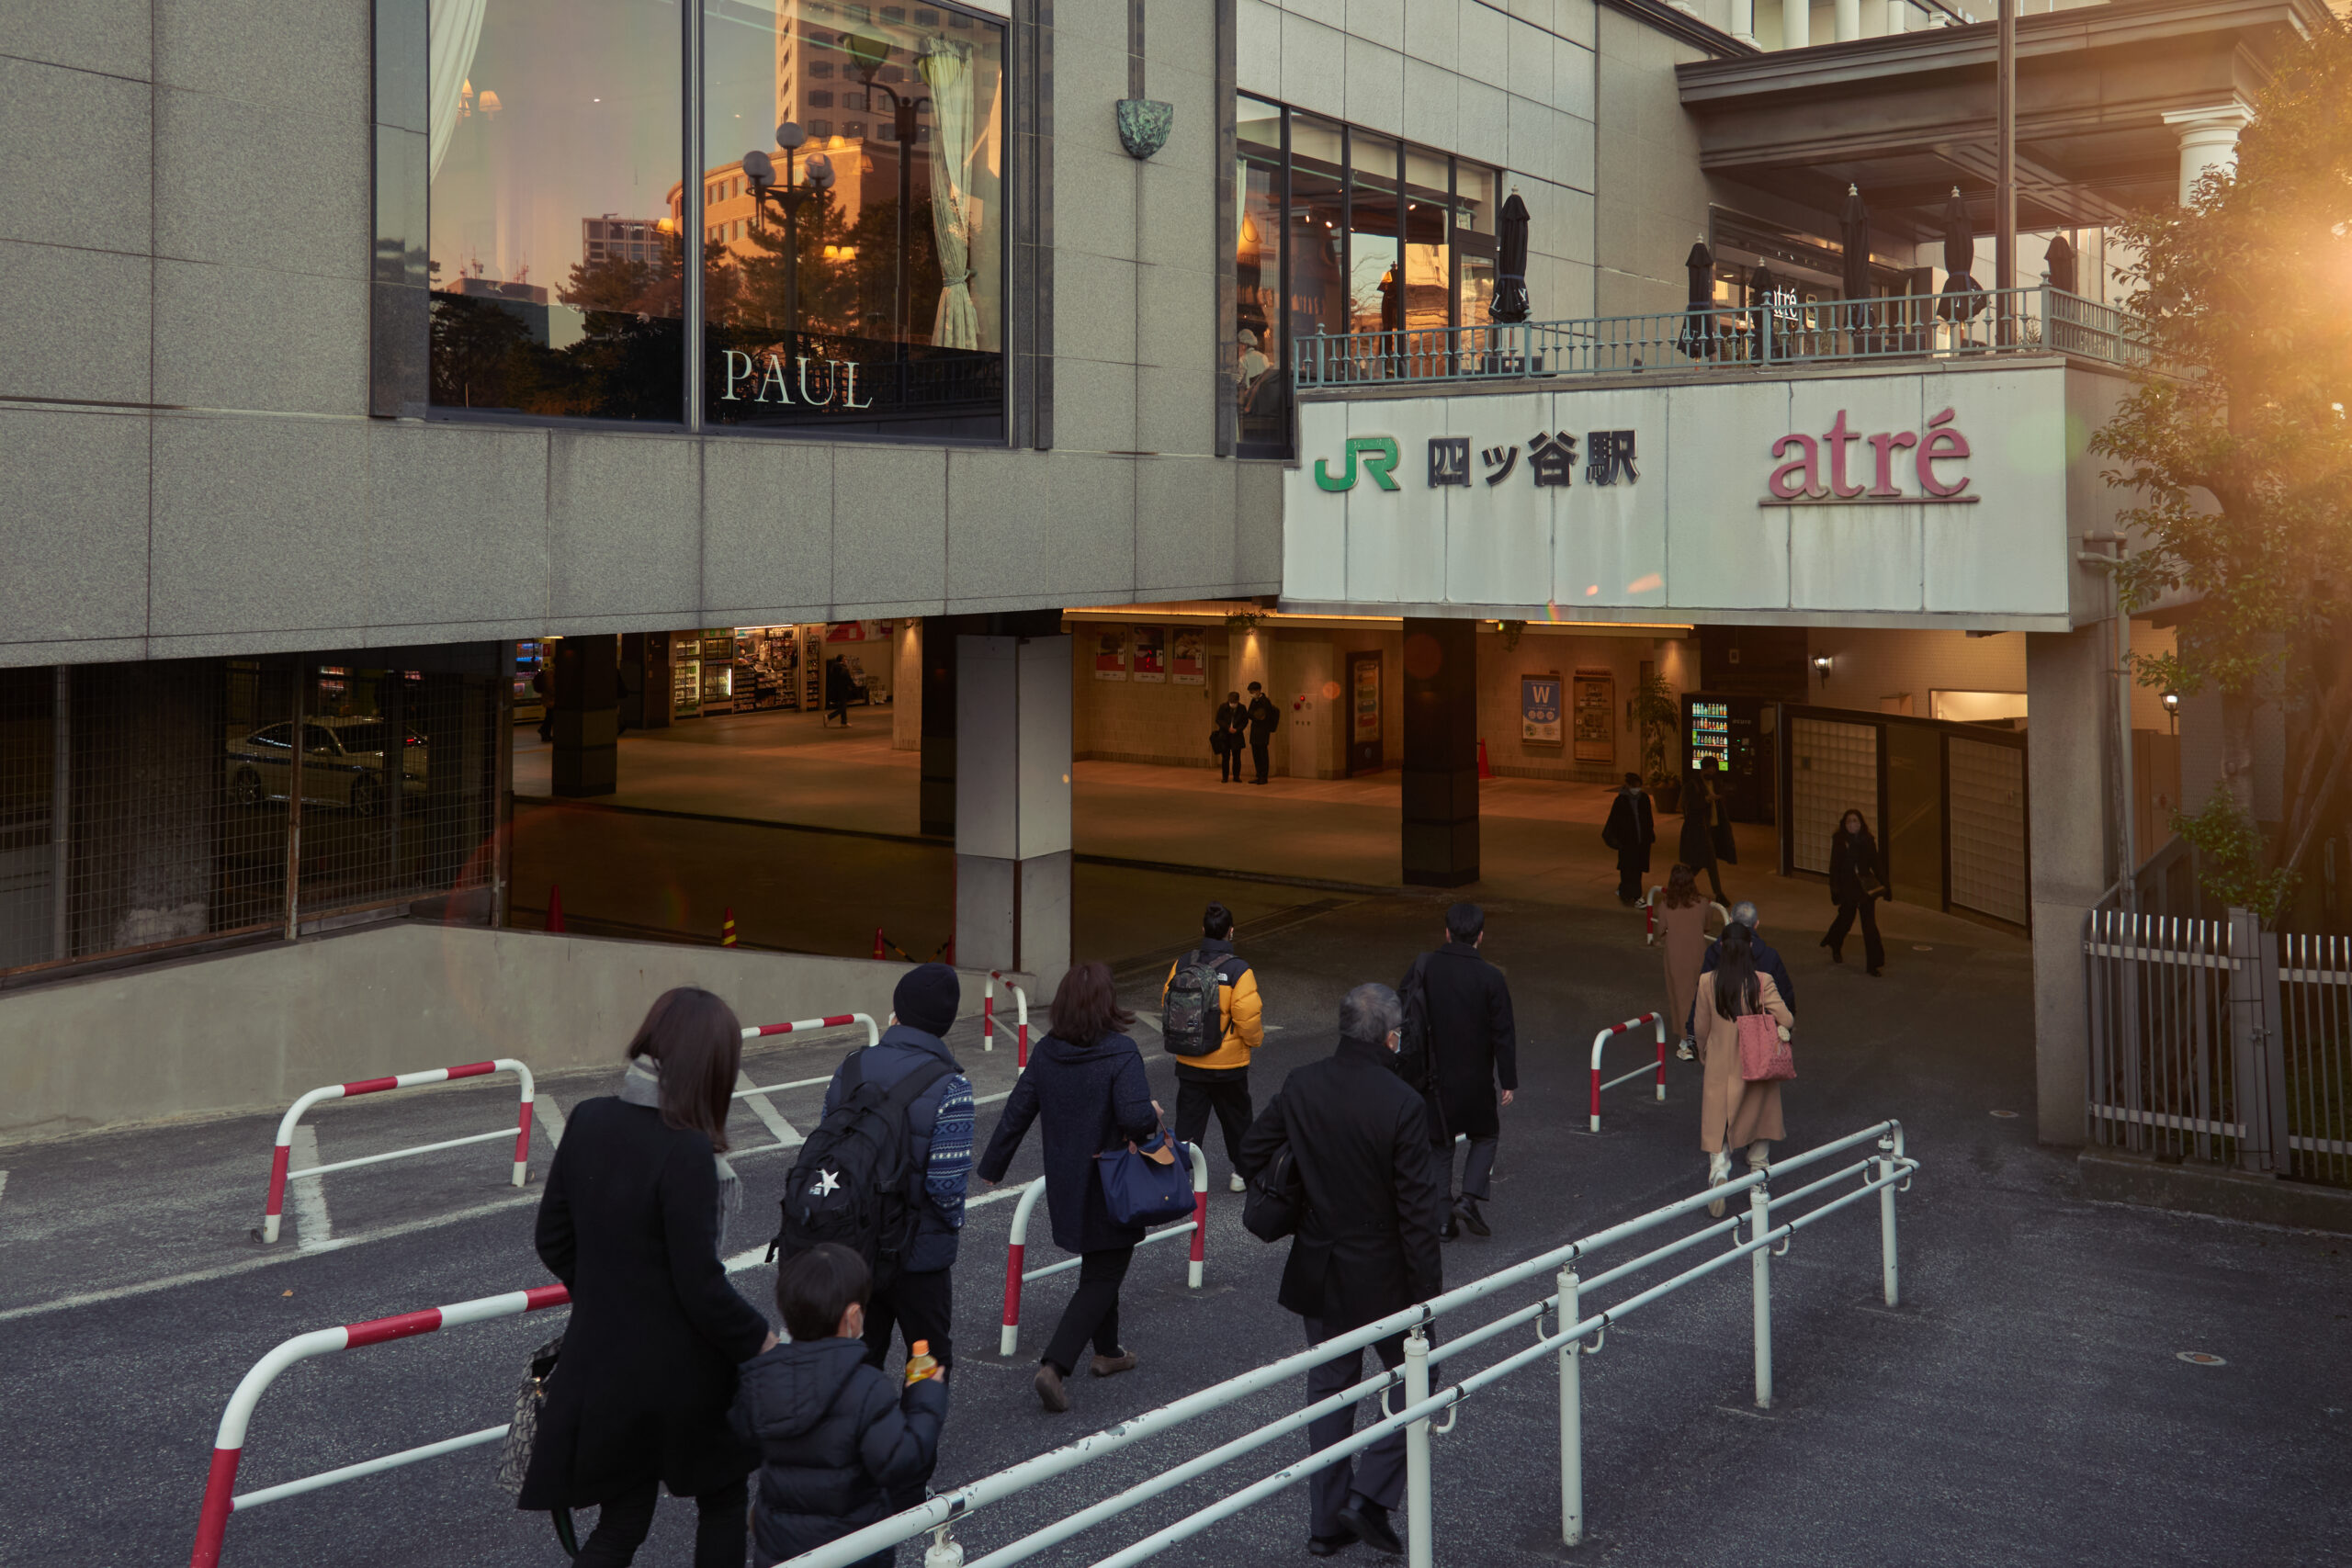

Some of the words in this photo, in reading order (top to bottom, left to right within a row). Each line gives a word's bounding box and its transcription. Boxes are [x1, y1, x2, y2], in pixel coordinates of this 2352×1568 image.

[721, 350, 873, 409] PAUL
[1315, 437, 1401, 491] JR
[1769, 407, 1972, 499] atré
[1532, 686, 1550, 704] W
